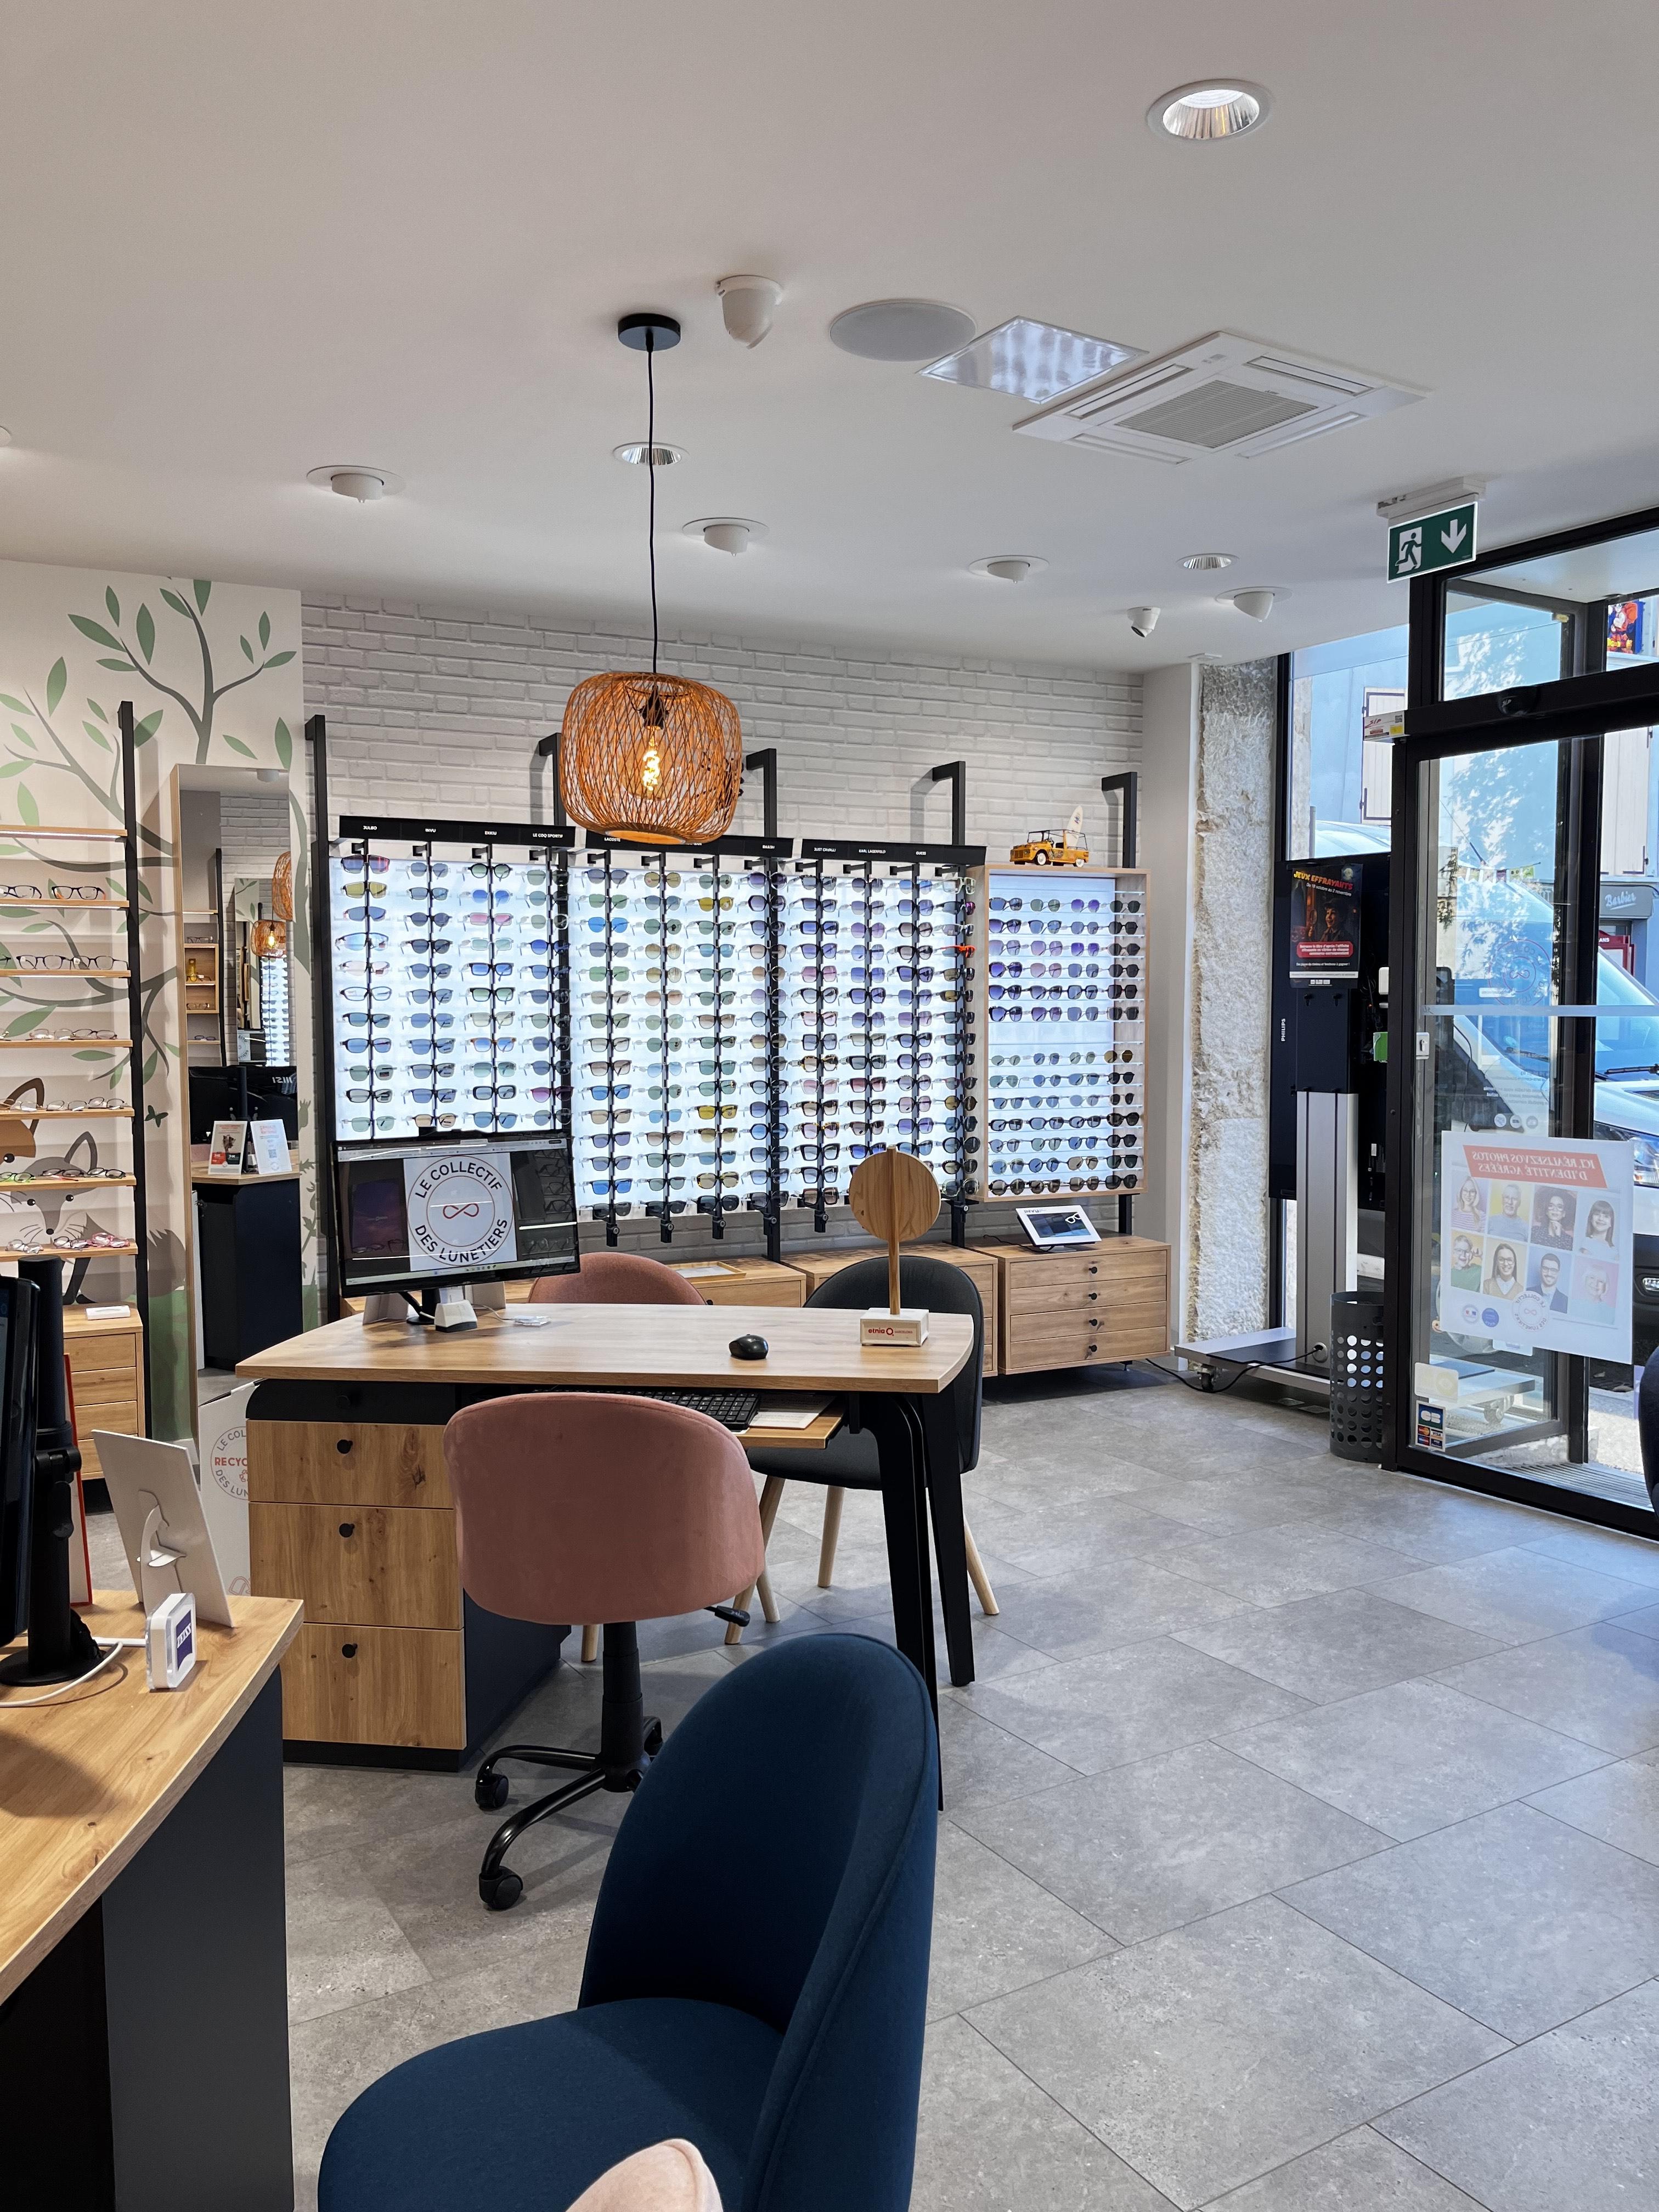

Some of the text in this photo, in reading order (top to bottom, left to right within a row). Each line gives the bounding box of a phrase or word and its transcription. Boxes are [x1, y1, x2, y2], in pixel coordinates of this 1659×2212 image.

[1294, 871, 1353, 890] JEUX EFFRAYANTS
[1605, 891, 1637, 907] Barbier
[415, 1161, 503, 1198] LE COLLECTIF
[415, 1219, 507, 1263] DES LUNETIERS
[217, 1430, 246, 1451] LE COL
[215, 1457, 247, 1466] RECYC
[216, 1469, 249, 1497] DES LUN
[177, 1622, 191, 1649] ZEISS
